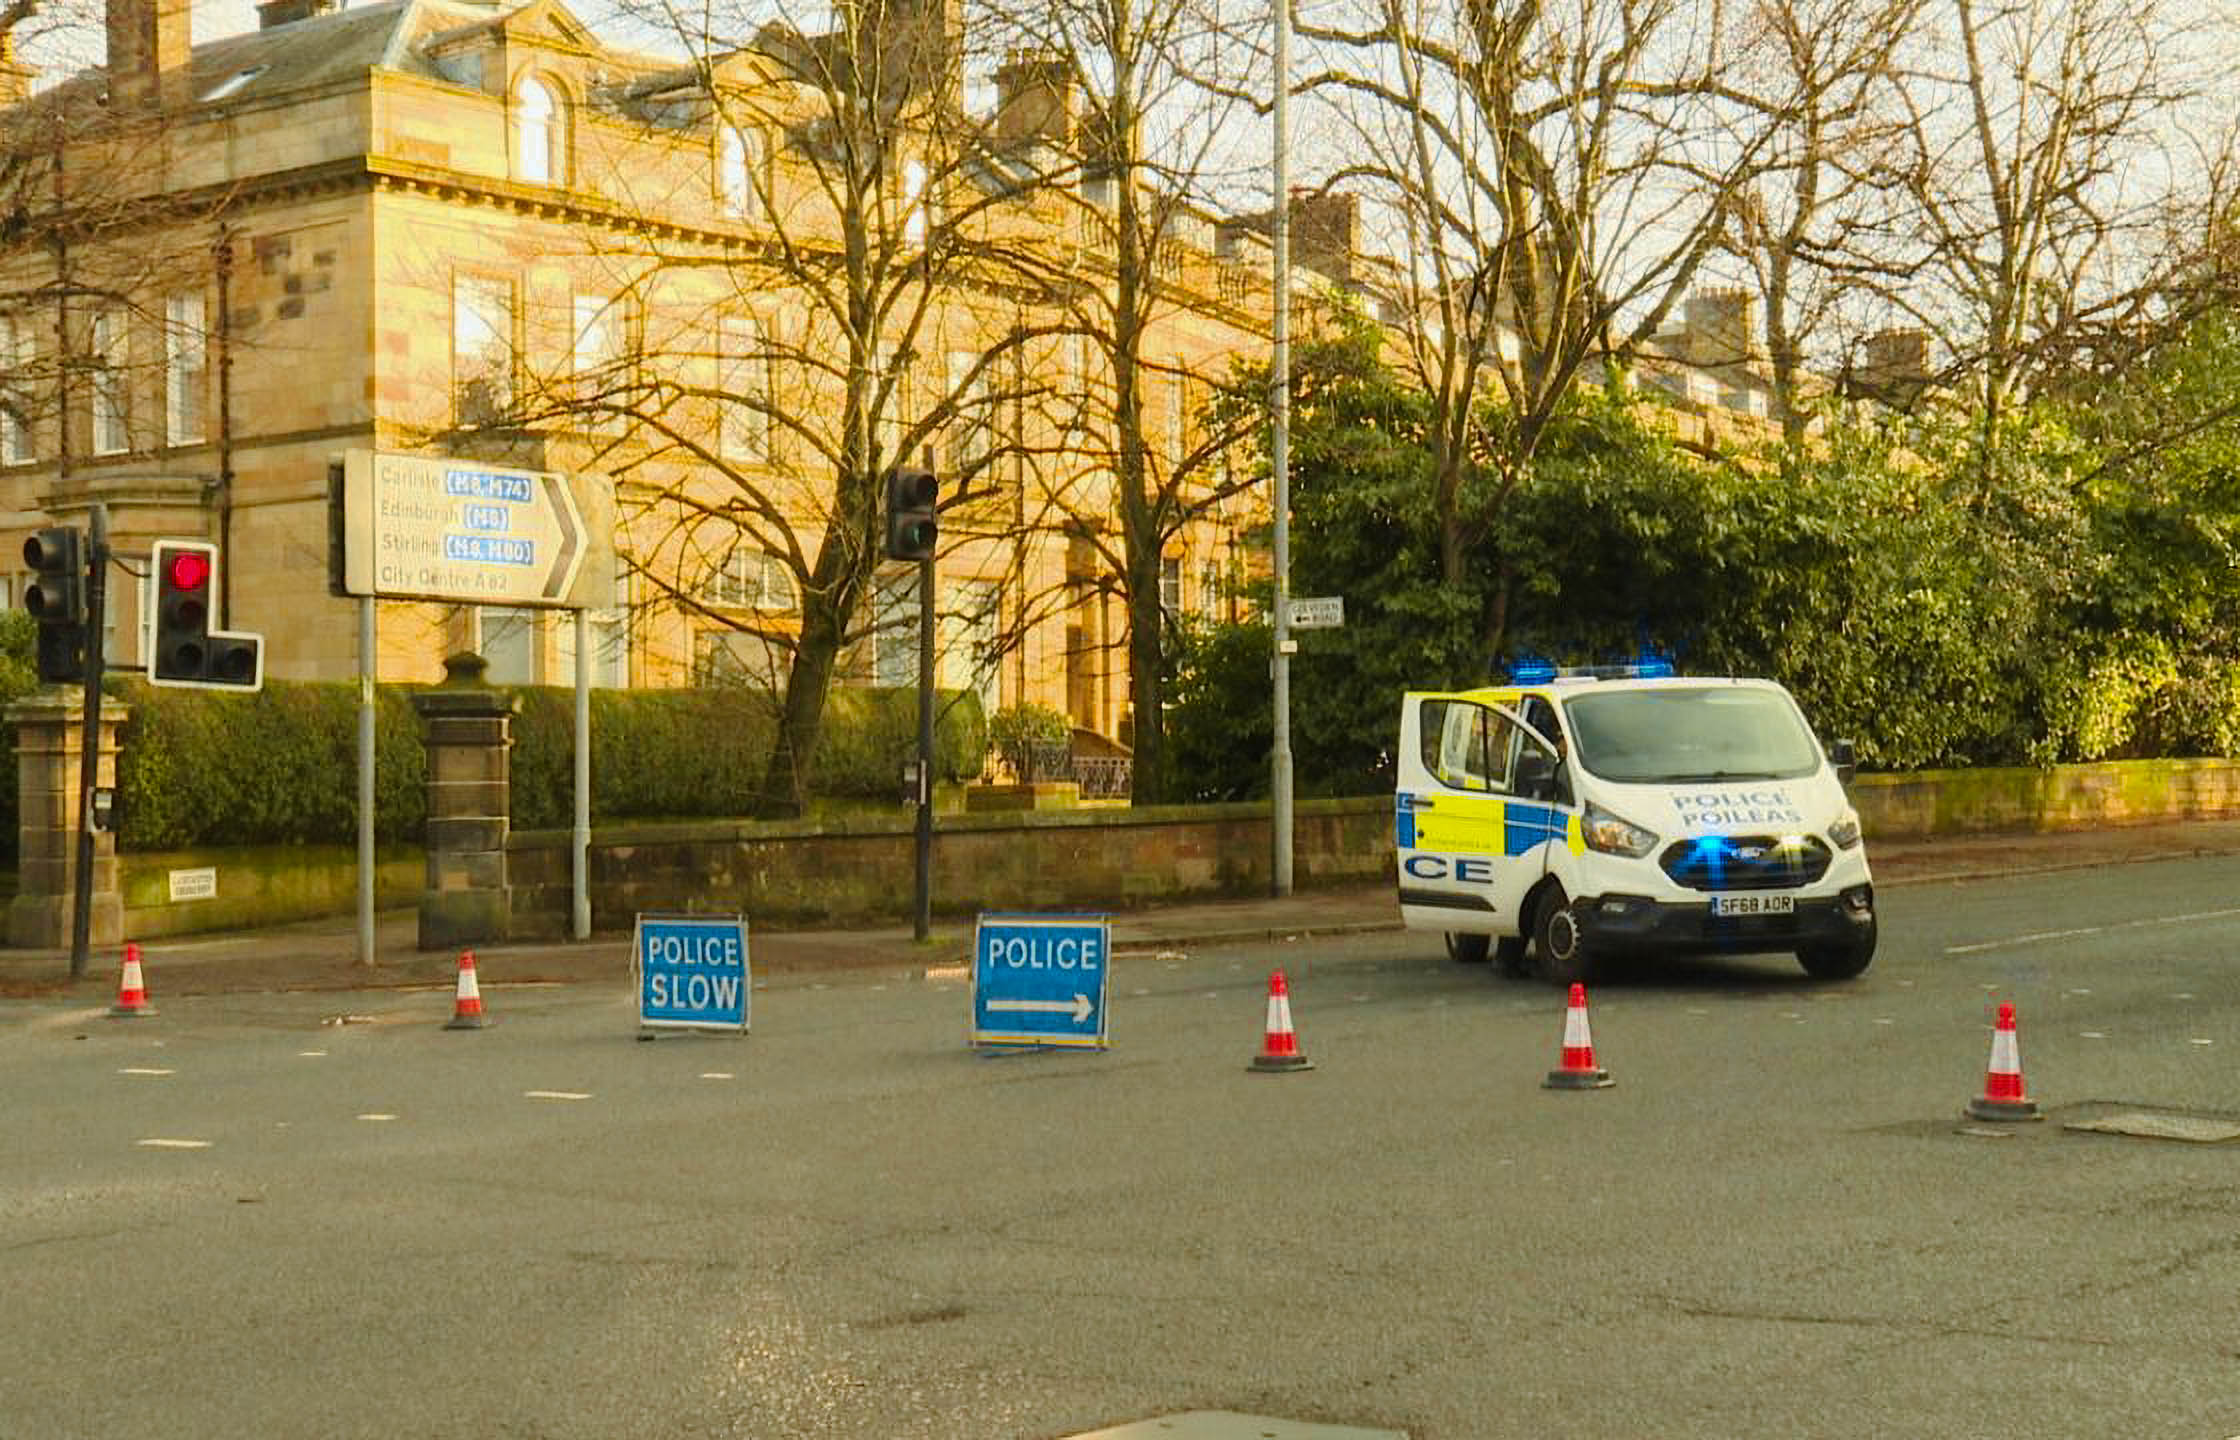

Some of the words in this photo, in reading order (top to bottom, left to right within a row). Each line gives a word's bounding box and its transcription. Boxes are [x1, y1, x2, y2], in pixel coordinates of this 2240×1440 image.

[381, 465, 439, 489] Carlisle
[381, 503, 459, 526] Edinburgh
[382, 534, 441, 556] Stirling
[382, 566, 413, 586] City
[419, 568, 470, 587] Centre
[1672, 791, 1793, 810] POLICE
[1682, 810, 1803, 827] POILEAS
[1719, 897, 1760, 914] SF68
[648, 935, 739, 966] POLICE
[989, 937, 1097, 970] POLICE
[651, 973, 739, 1011] SLOW
